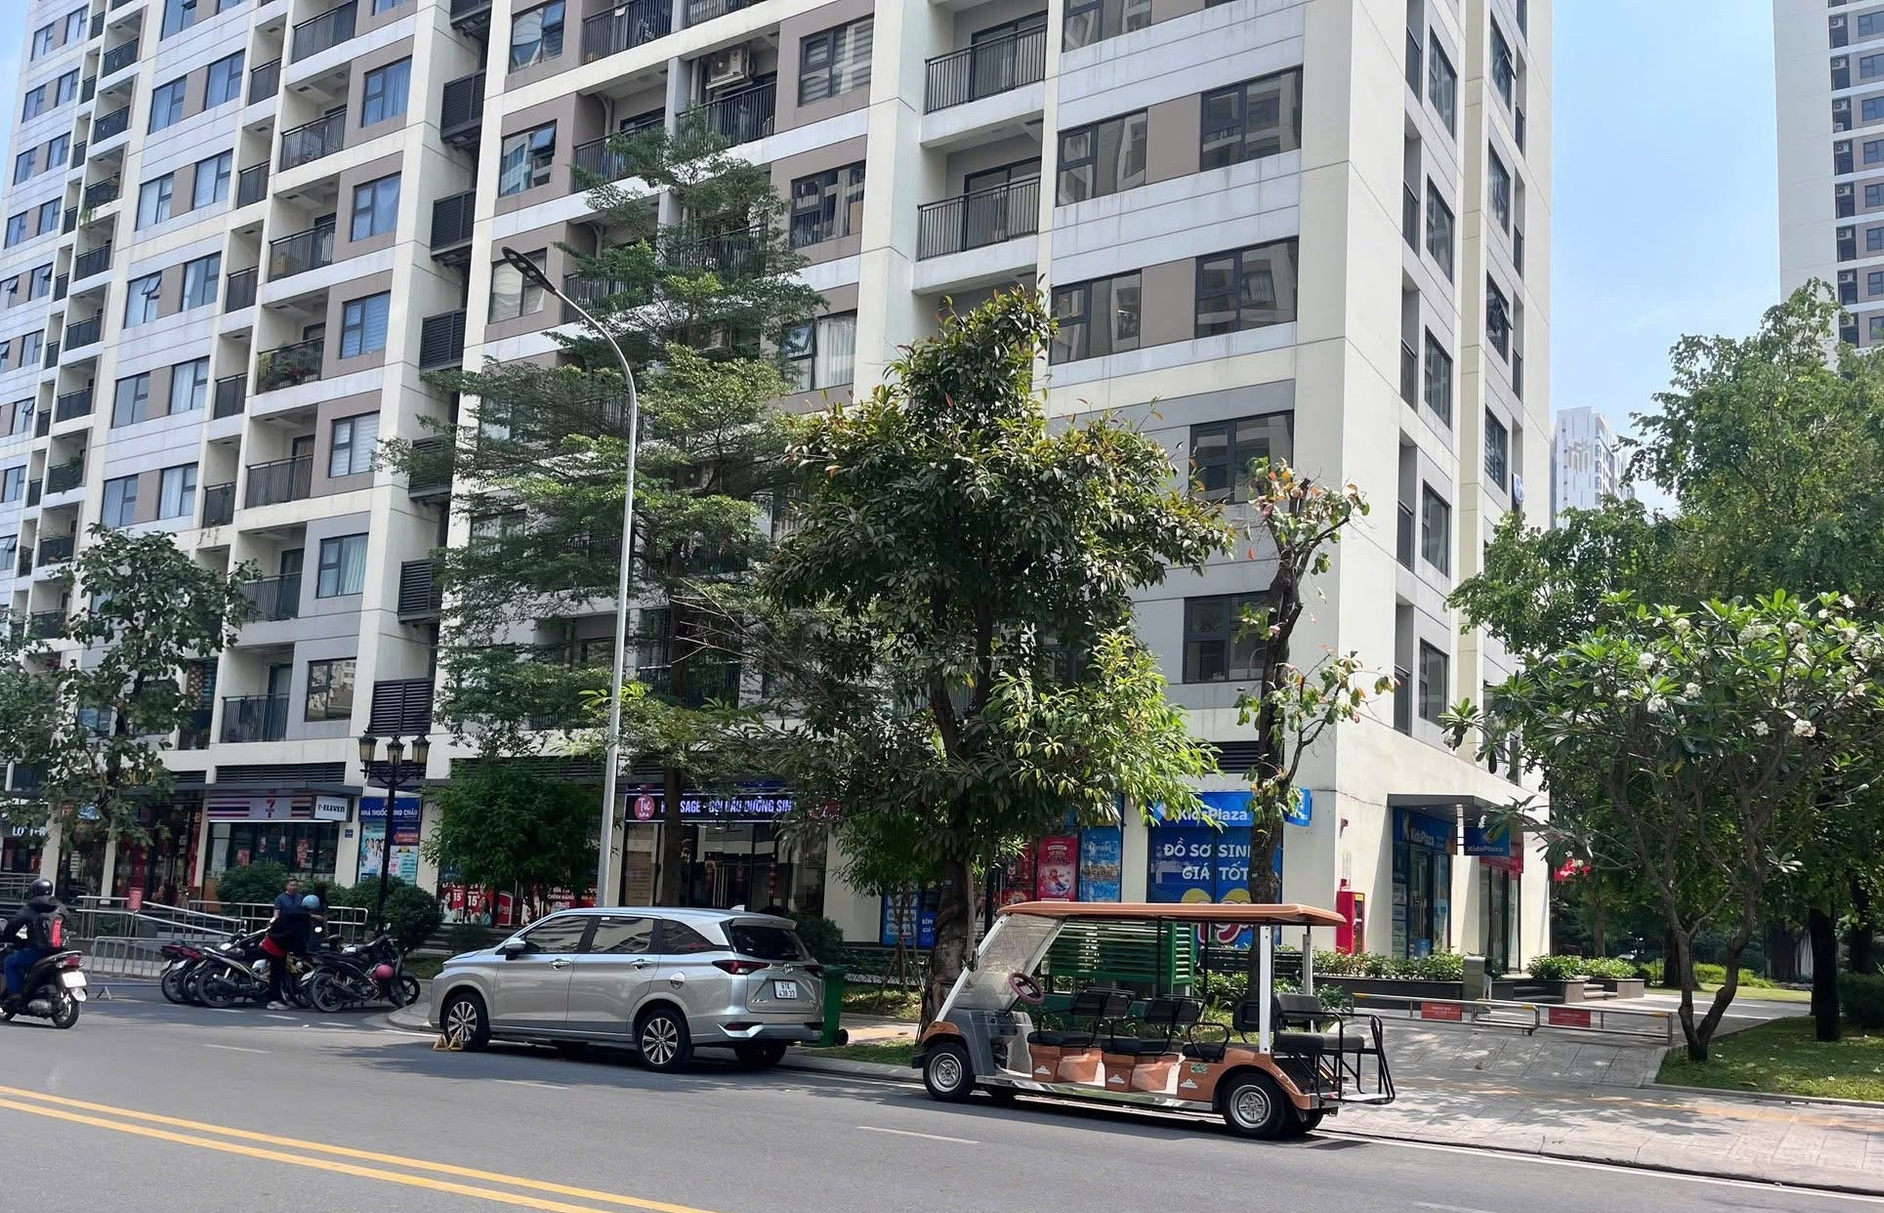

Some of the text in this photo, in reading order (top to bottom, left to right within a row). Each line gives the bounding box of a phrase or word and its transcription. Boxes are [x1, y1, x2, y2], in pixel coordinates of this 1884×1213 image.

[1163, 837, 1251, 858] ĐỒ SƠ SIN
[1467, 844, 1504, 853] KidsPlaza
[1181, 861, 1249, 881] GIÁ TỐT
